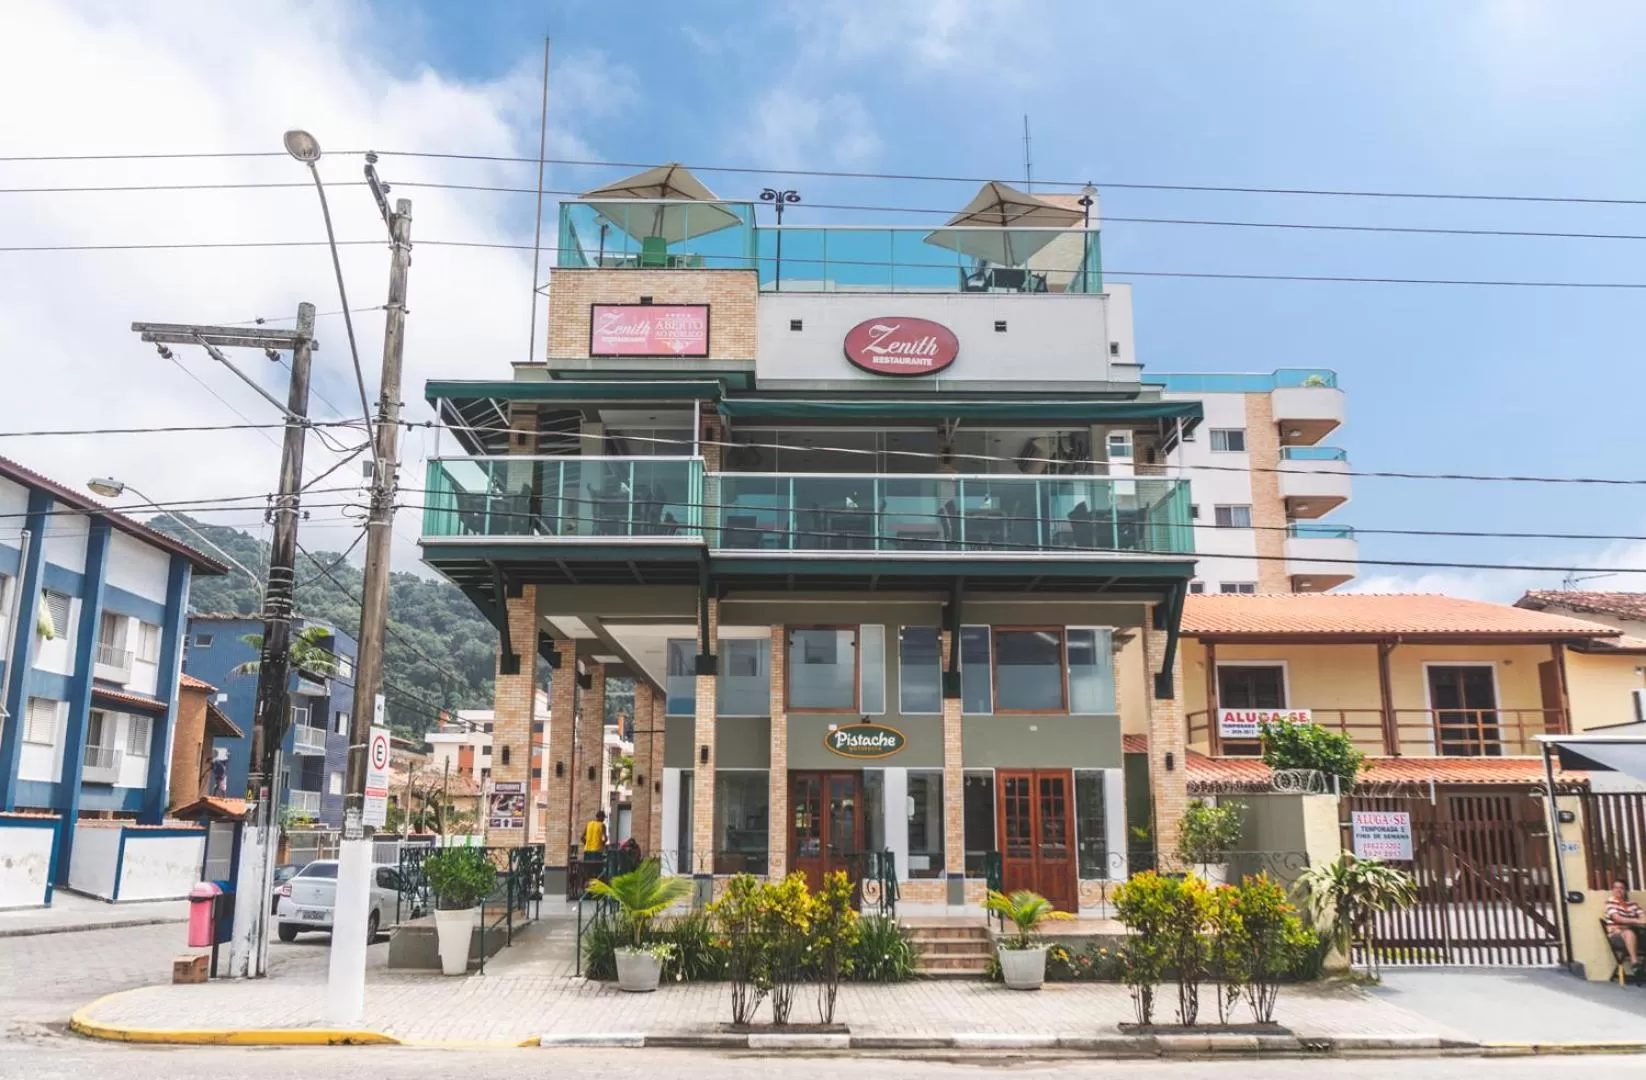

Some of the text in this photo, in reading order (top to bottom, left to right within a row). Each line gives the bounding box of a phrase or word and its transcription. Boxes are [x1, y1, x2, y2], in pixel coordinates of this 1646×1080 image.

[595, 311, 651, 337] Zenith
[655, 319, 703, 330] ABERTO
[861, 324, 939, 356] Zenith
[872, 356, 933, 366] RESTAURANTE
[834, 731, 896, 749] Pistache
[376, 744, 383, 762] E
[1356, 814, 1405, 825] ALUGA-SE
